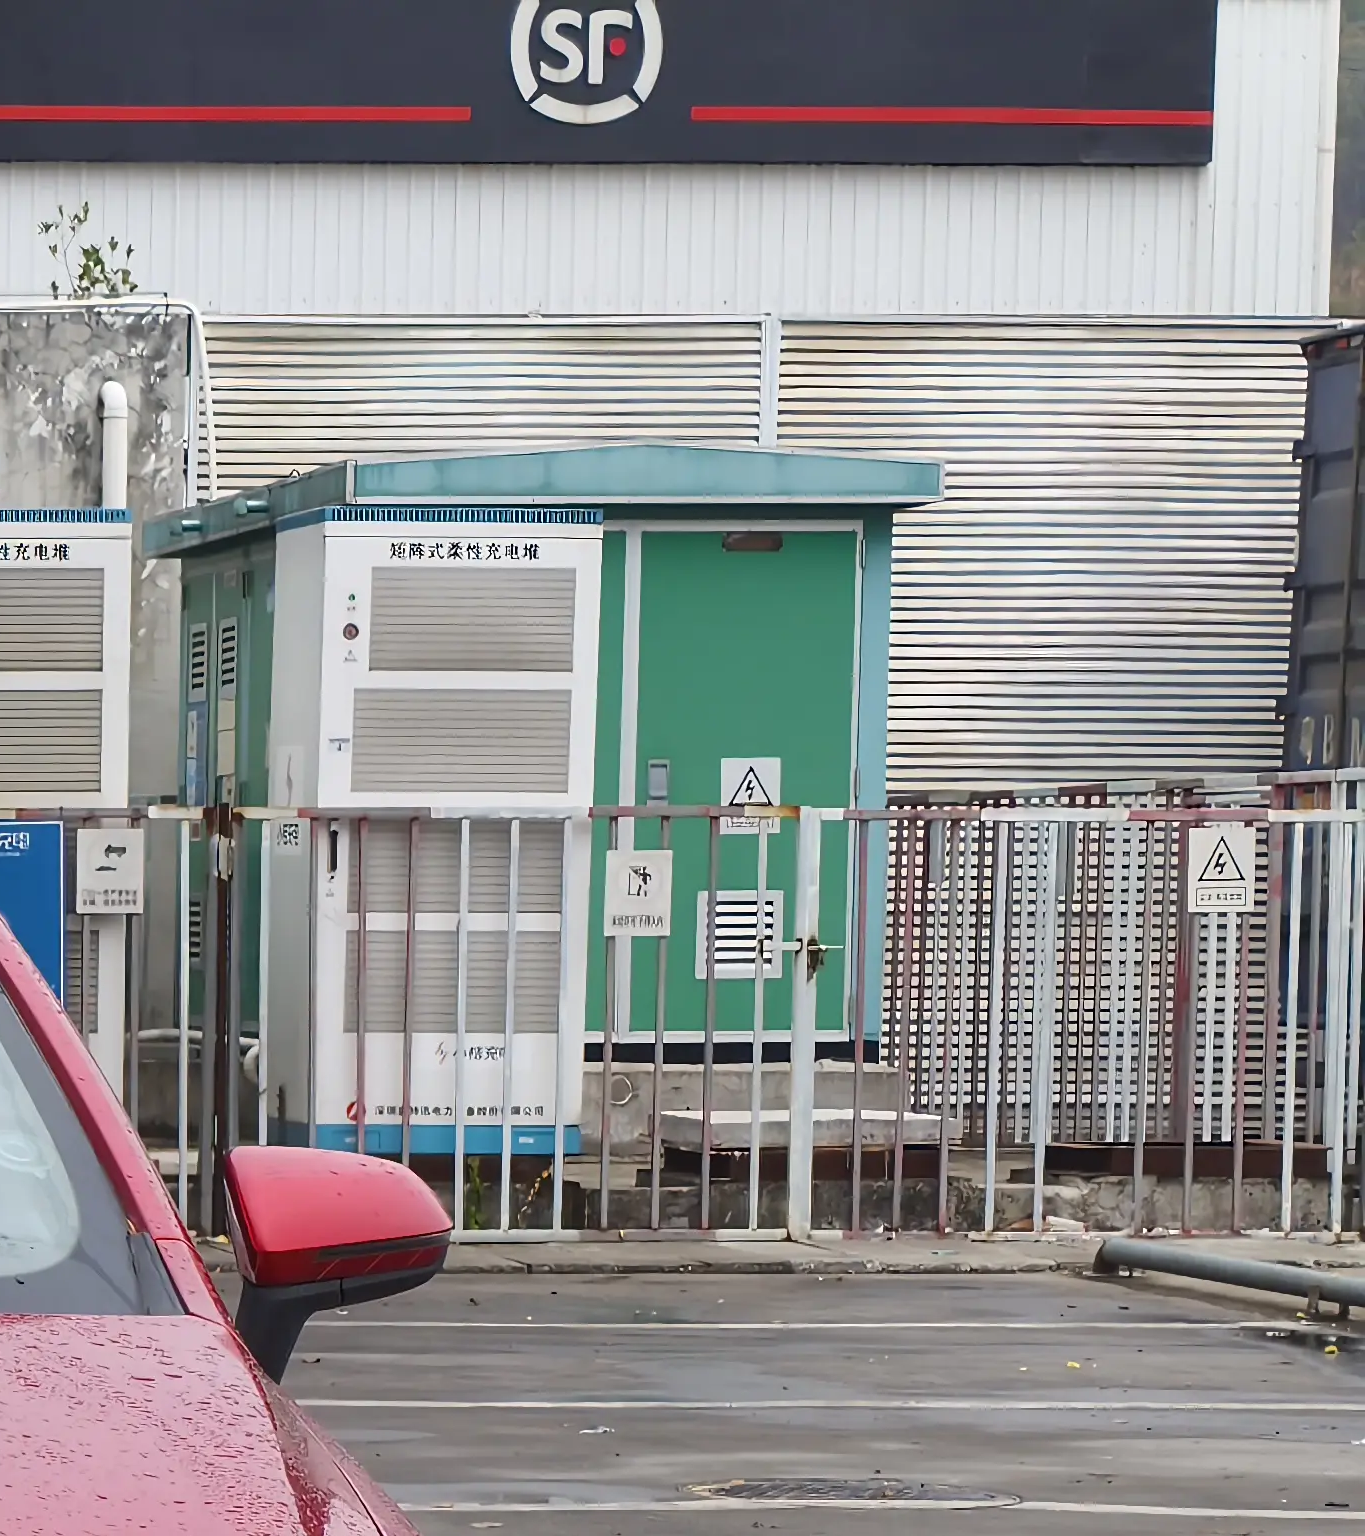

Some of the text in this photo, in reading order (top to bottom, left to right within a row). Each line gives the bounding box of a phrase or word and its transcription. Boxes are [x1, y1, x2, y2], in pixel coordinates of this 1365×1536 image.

[540, 8, 633, 85] SF
[390, 541, 540, 560] 矩阵式柔性充电堆
